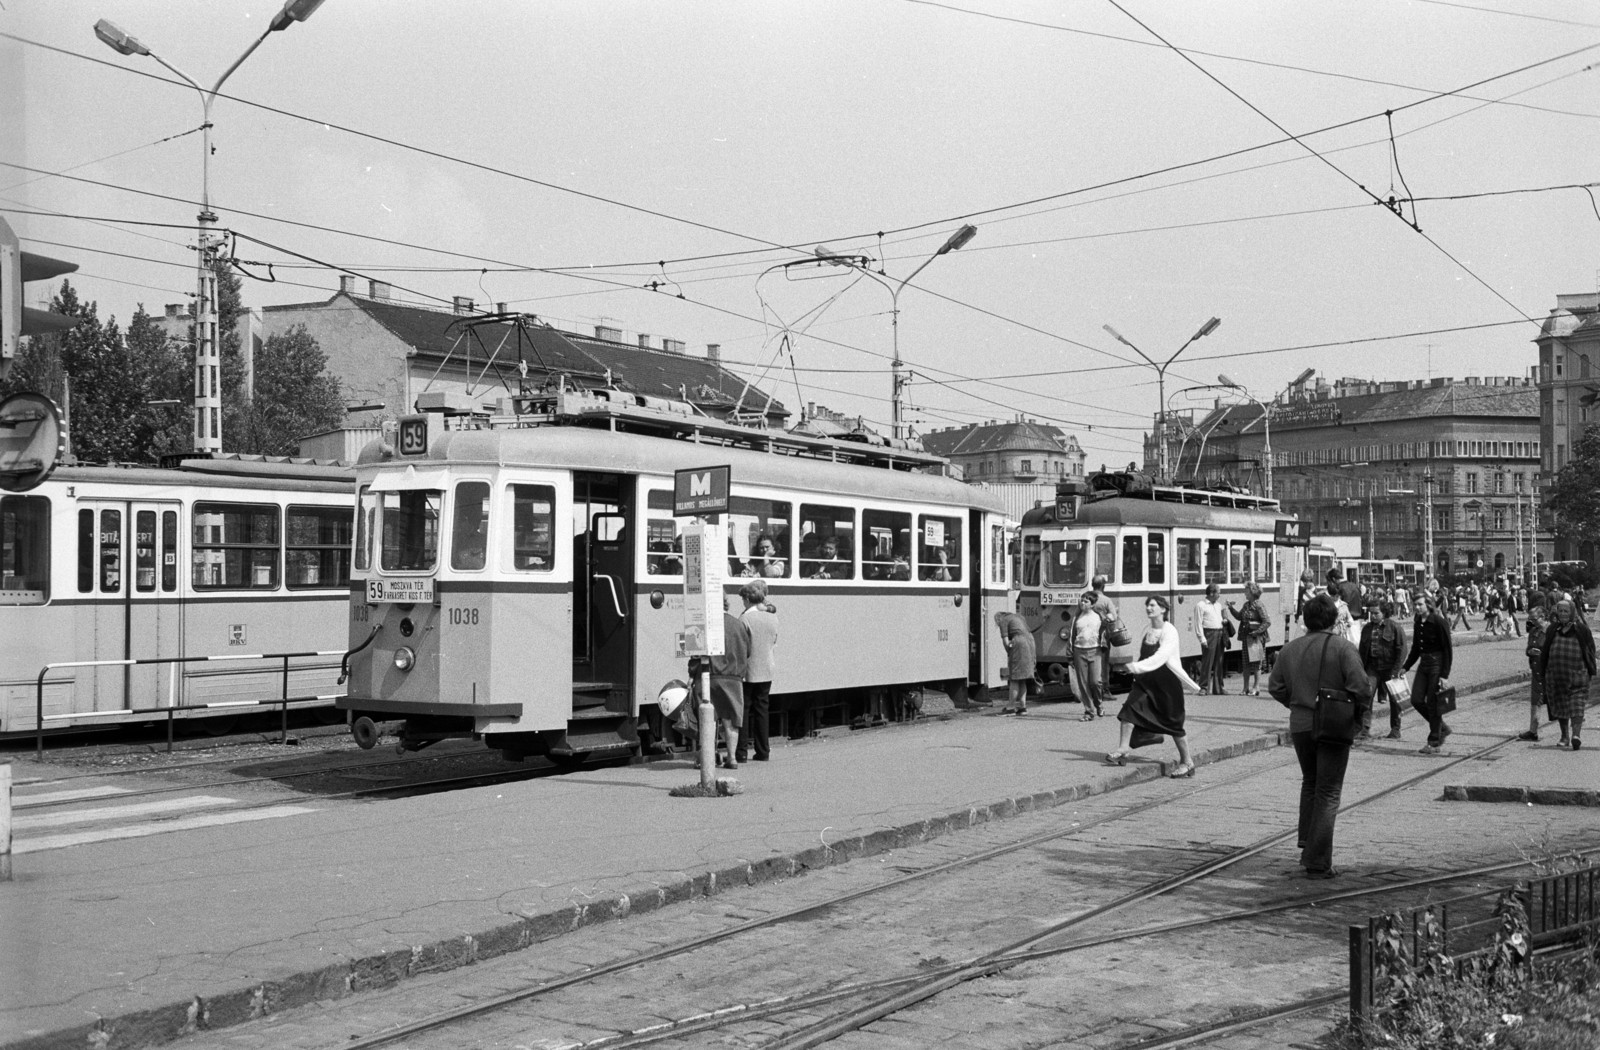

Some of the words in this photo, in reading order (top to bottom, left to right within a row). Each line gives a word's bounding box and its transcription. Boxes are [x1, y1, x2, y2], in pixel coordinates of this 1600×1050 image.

[405, 425, 424, 448] 59
[690, 471, 711, 497] M
[1060, 502, 1073, 515] 59
[1285, 523, 1300, 536] M
[370, 582, 383, 599] 59
[1043, 593, 1053, 604] 59
[353, 605, 369, 622] 1038
[448, 607, 480, 625] 1038
[1024, 606, 1039, 617] 1064
